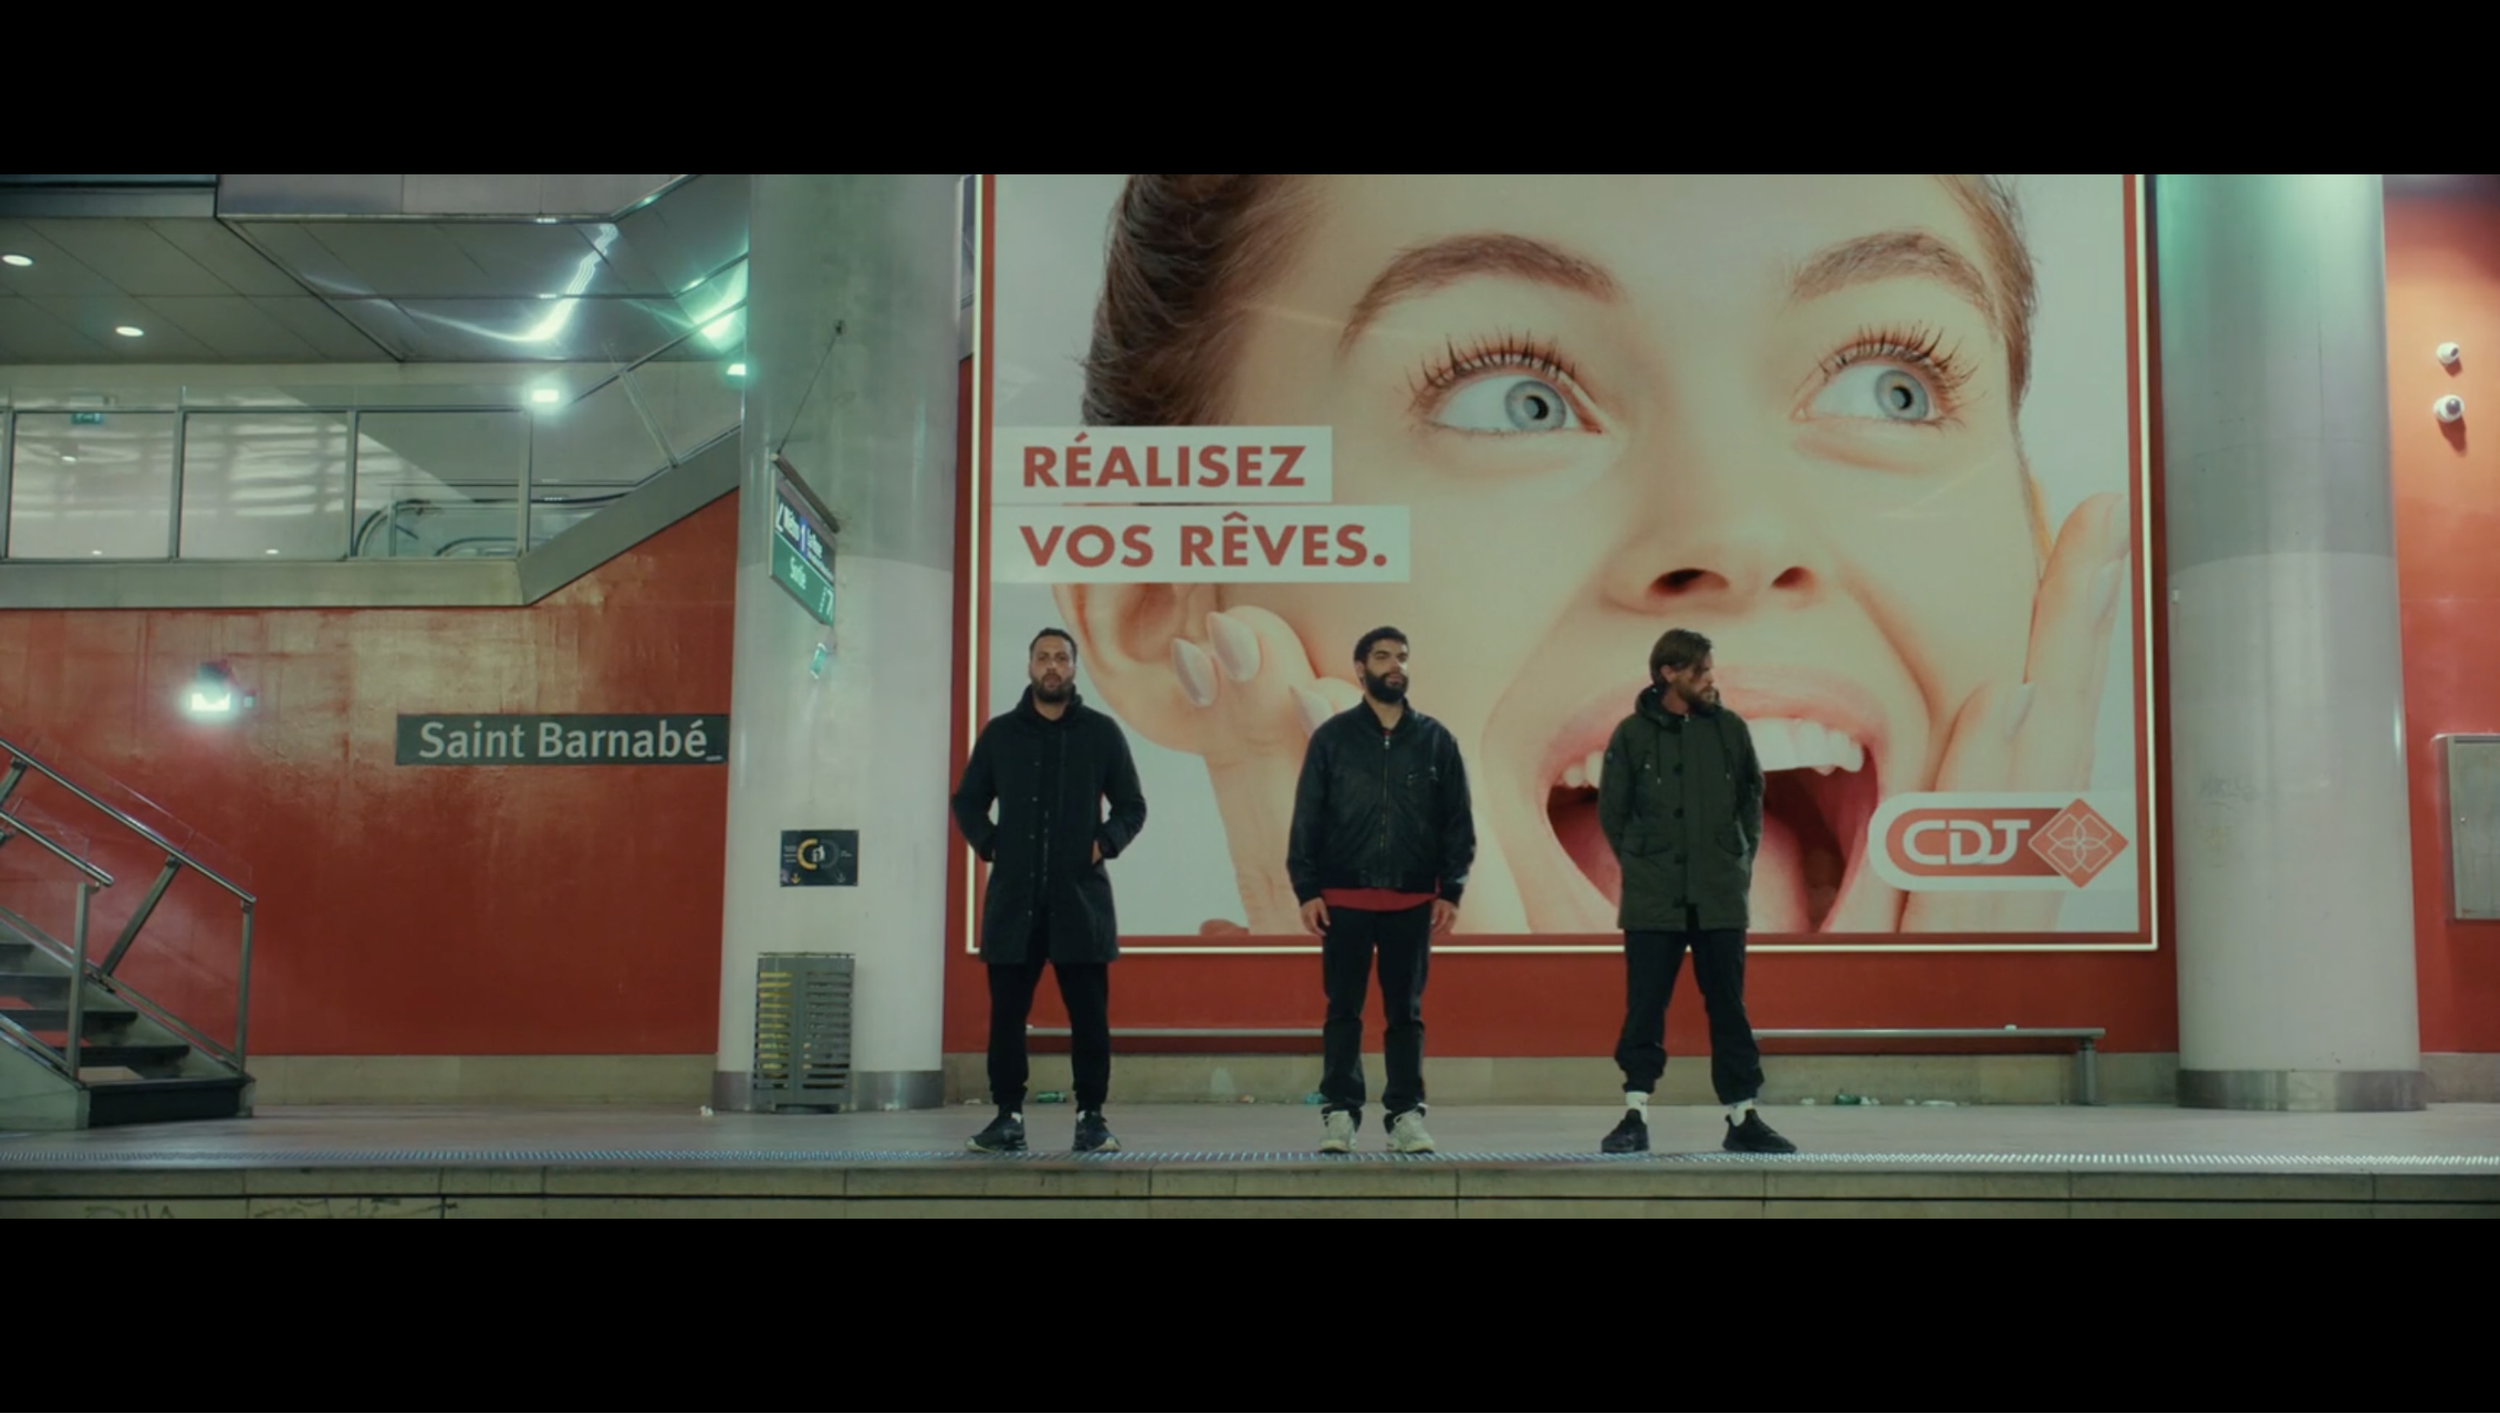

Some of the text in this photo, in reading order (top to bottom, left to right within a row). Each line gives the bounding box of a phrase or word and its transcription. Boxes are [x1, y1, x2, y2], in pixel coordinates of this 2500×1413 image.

[1023, 431, 1307, 488] RÉALISEZ
[1019, 511, 1388, 568] VOS RÊVES.
[418, 720, 526, 759] Saint
